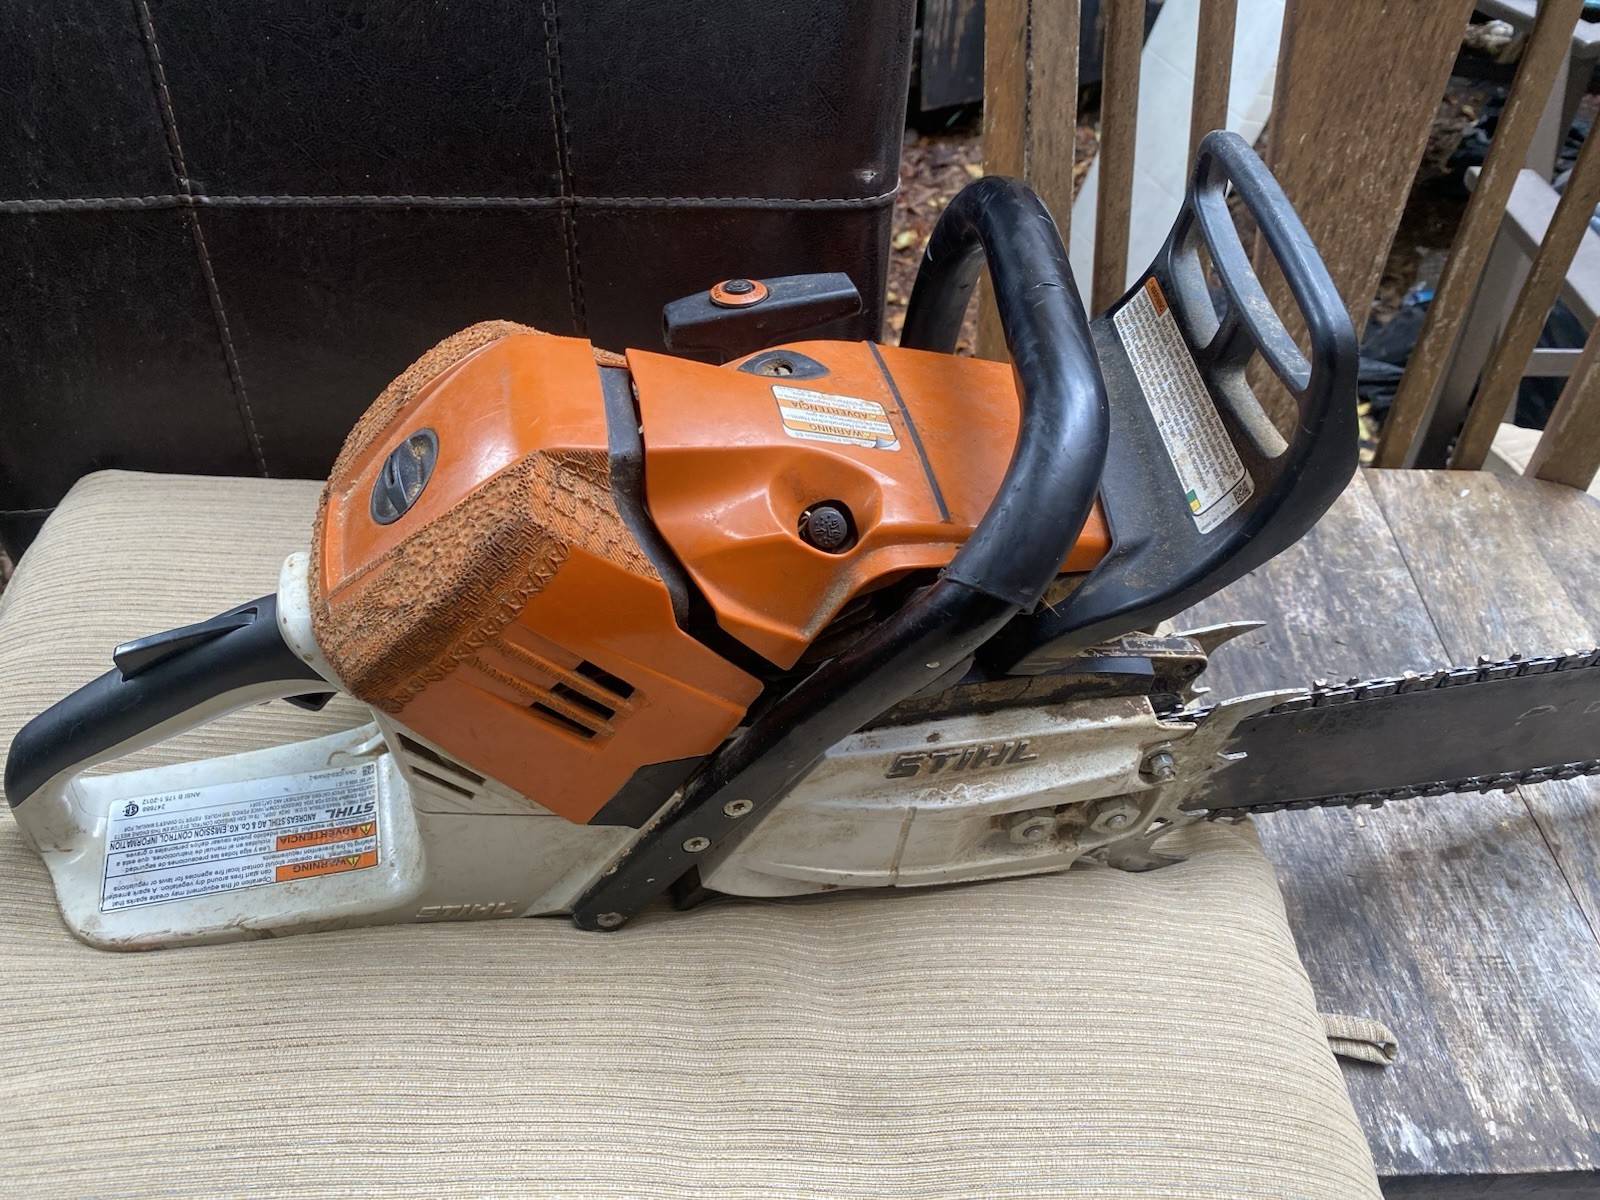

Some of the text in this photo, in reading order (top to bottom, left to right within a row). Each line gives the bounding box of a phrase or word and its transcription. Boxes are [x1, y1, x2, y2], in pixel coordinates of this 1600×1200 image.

[790, 401, 869, 419] ADVERTENCIA
[808, 423, 863, 437] WARNING
[887, 739, 1037, 779] STIHL
[325, 802, 374, 818] STIHL
[268, 816, 285, 826] STIHL
[286, 812, 316, 823] ANDREAS
[159, 830, 191, 842] CONTROL
[194, 825, 226, 837] EMISSION
[279, 826, 357, 845] ADVERTENCIA
[109, 835, 157, 850] INFORMATION
[203, 845, 226, 853] manual
[292, 857, 345, 873] WARNING
[195, 878, 205, 886] dry
[206, 875, 228, 884] around
[132, 886, 150, 896] spark
[186, 883, 219, 894] equipment
[125, 895, 147, 904] sparks
[415, 902, 516, 919] STIHL
